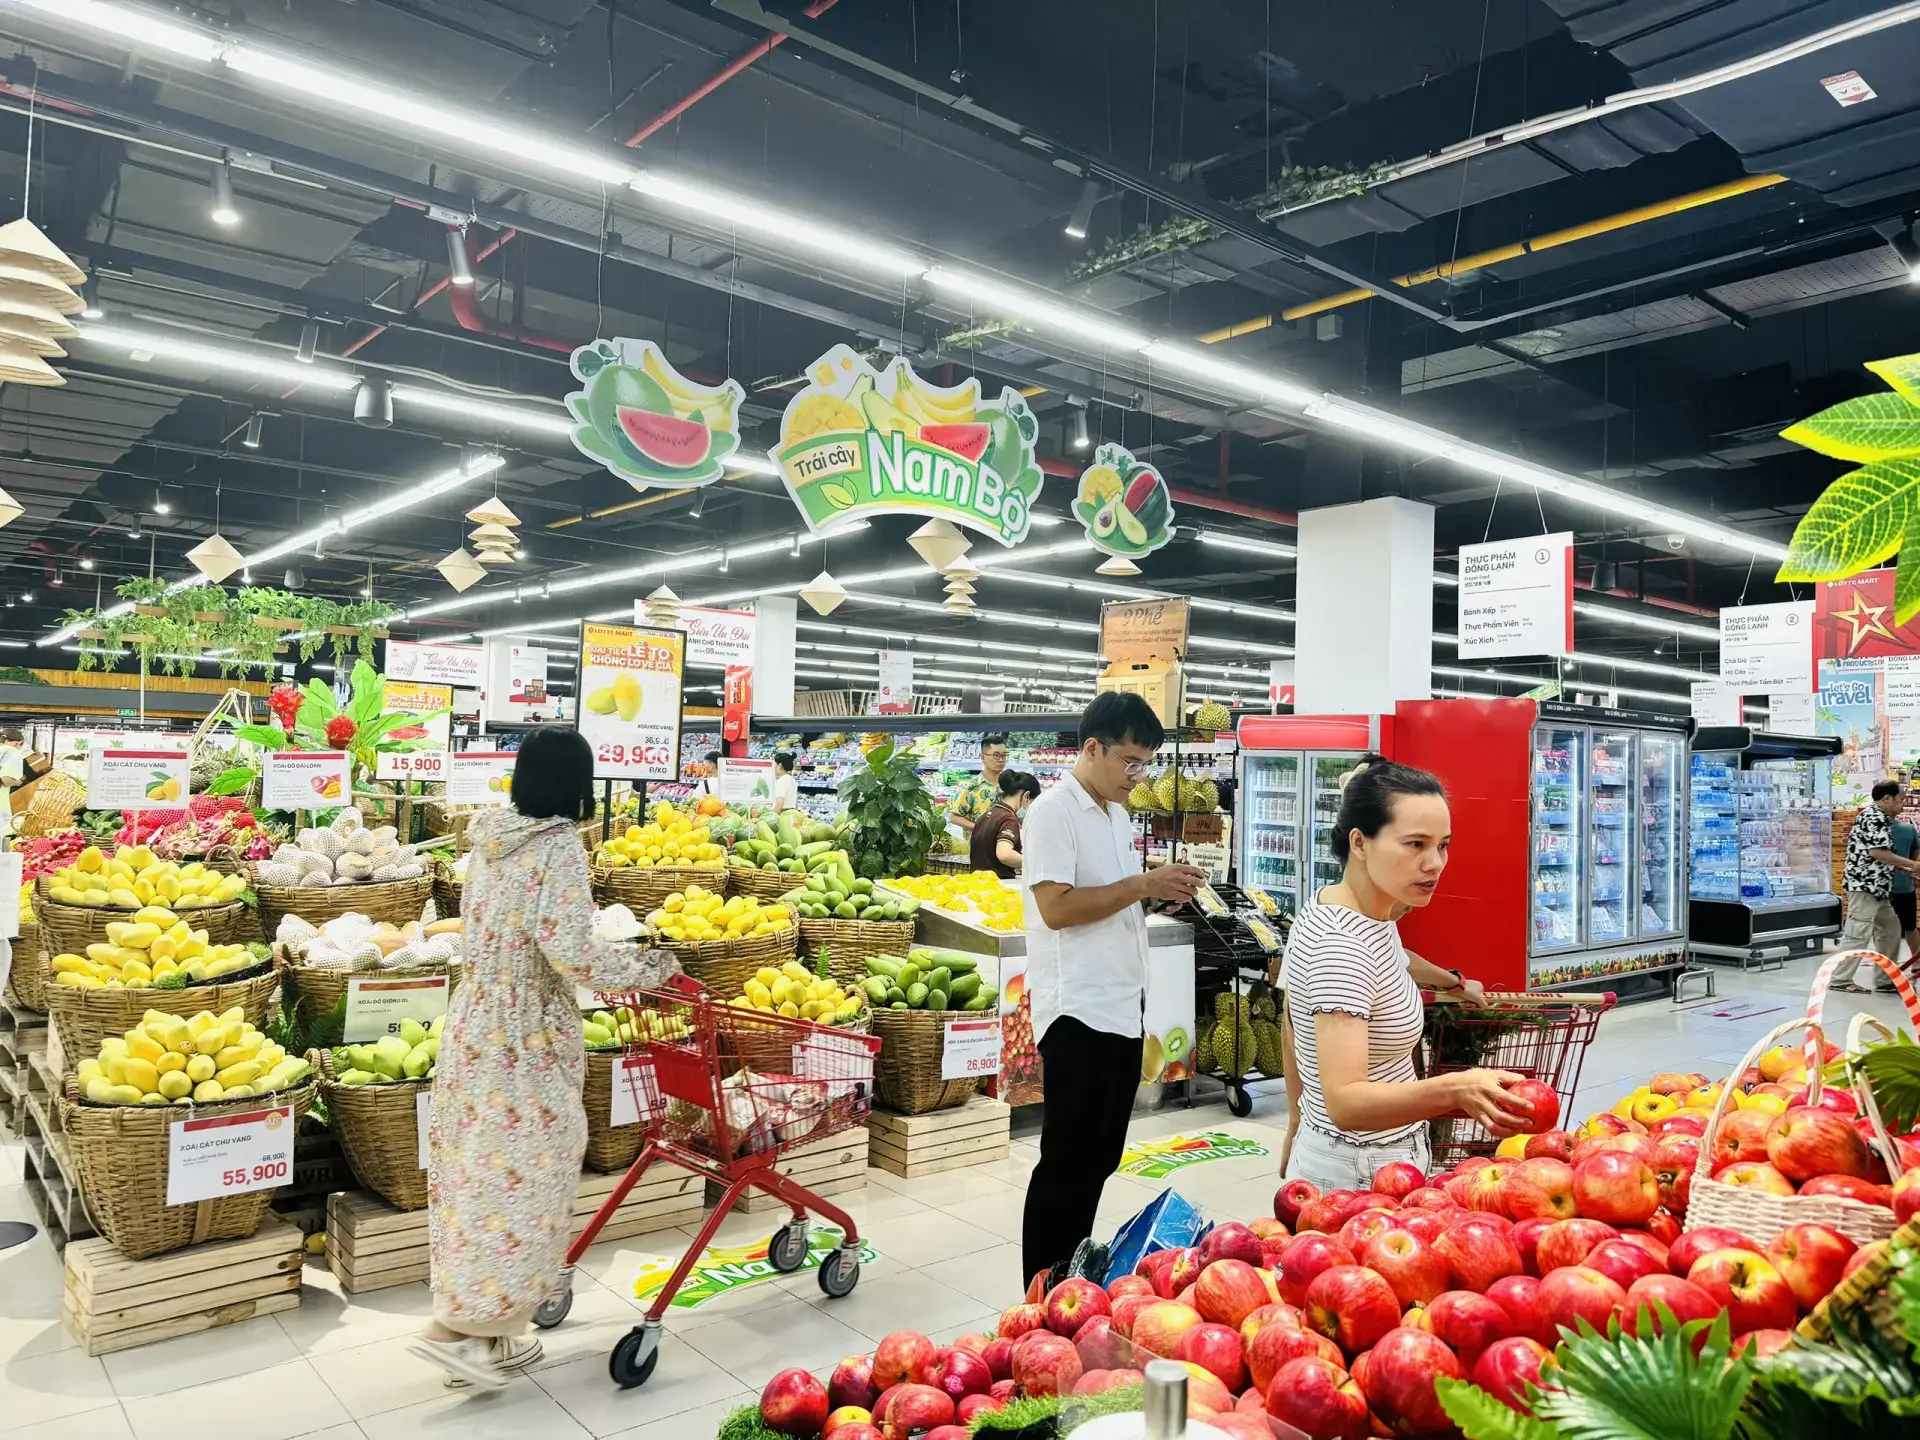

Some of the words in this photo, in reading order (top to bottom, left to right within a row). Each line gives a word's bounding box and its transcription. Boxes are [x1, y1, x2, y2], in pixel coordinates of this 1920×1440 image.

[794, 452, 828, 478] Trái
[830, 446, 857, 468] cây
[866, 430, 972, 506] Nam
[973, 462, 1028, 540] Bộ
[1540, 552, 1545, 560] 1
[1464, 622, 1482, 631] Thực
[1504, 620, 1519, 628] Viên
[715, 640, 735, 648] THÀNH
[1464, 636, 1477, 644] Xúc
[1478, 636, 1494, 644] Xích
[590, 655, 626, 666] KHÔNG
[628, 658, 641, 667] LO
[648, 649, 670, 661] TO
[1852, 682, 1864, 691] Go
[1818, 686, 1872, 706] Travel
[392, 758, 441, 772] 15,900
[967, 1058, 997, 1072] 26,900
[200, 1140, 214, 1149] CÁT
[1148, 1148, 1219, 1166] Nam
[223, 1162, 288, 1186] 55,900
